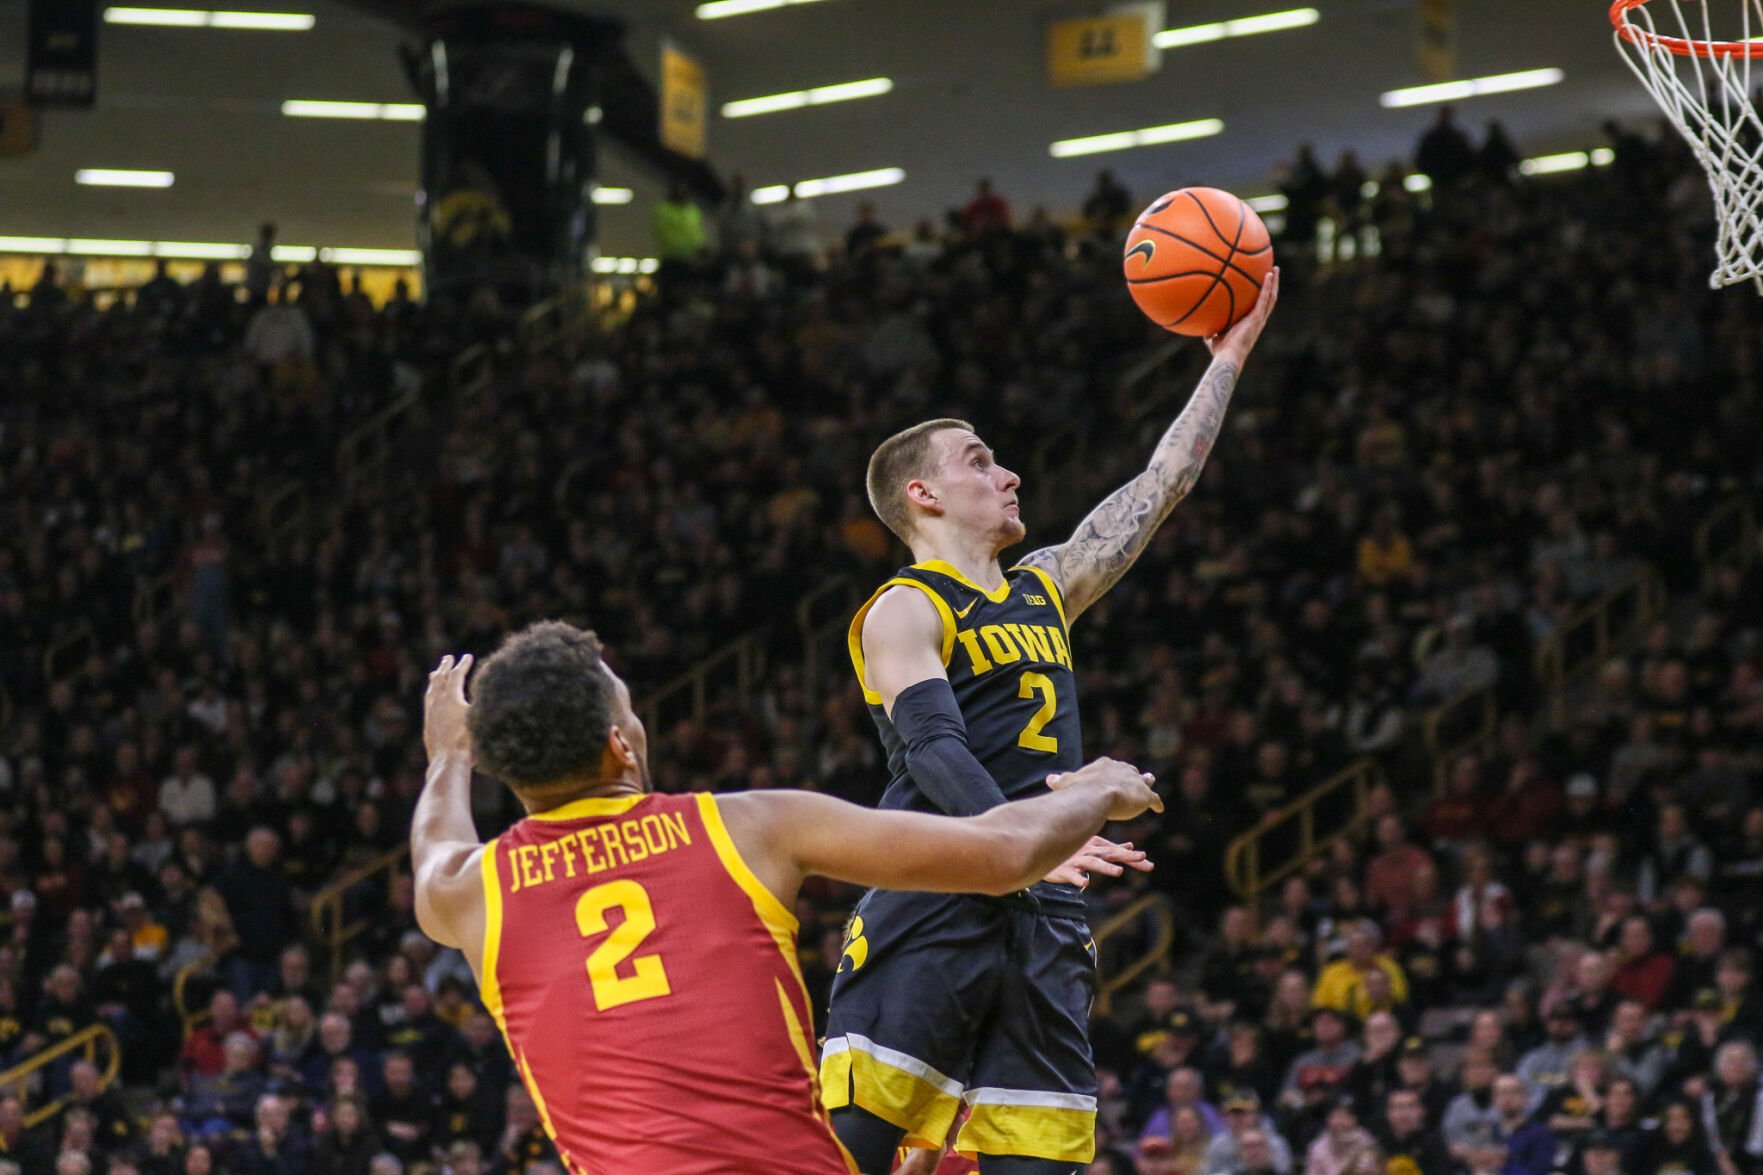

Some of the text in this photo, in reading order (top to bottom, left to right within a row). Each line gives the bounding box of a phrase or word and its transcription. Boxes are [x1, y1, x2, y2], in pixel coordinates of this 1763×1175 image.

[957, 623, 1073, 676] IOWA
[1018, 671, 1058, 754] 2
[507, 811, 692, 893] JEFFERSON
[575, 879, 671, 1012] 2
